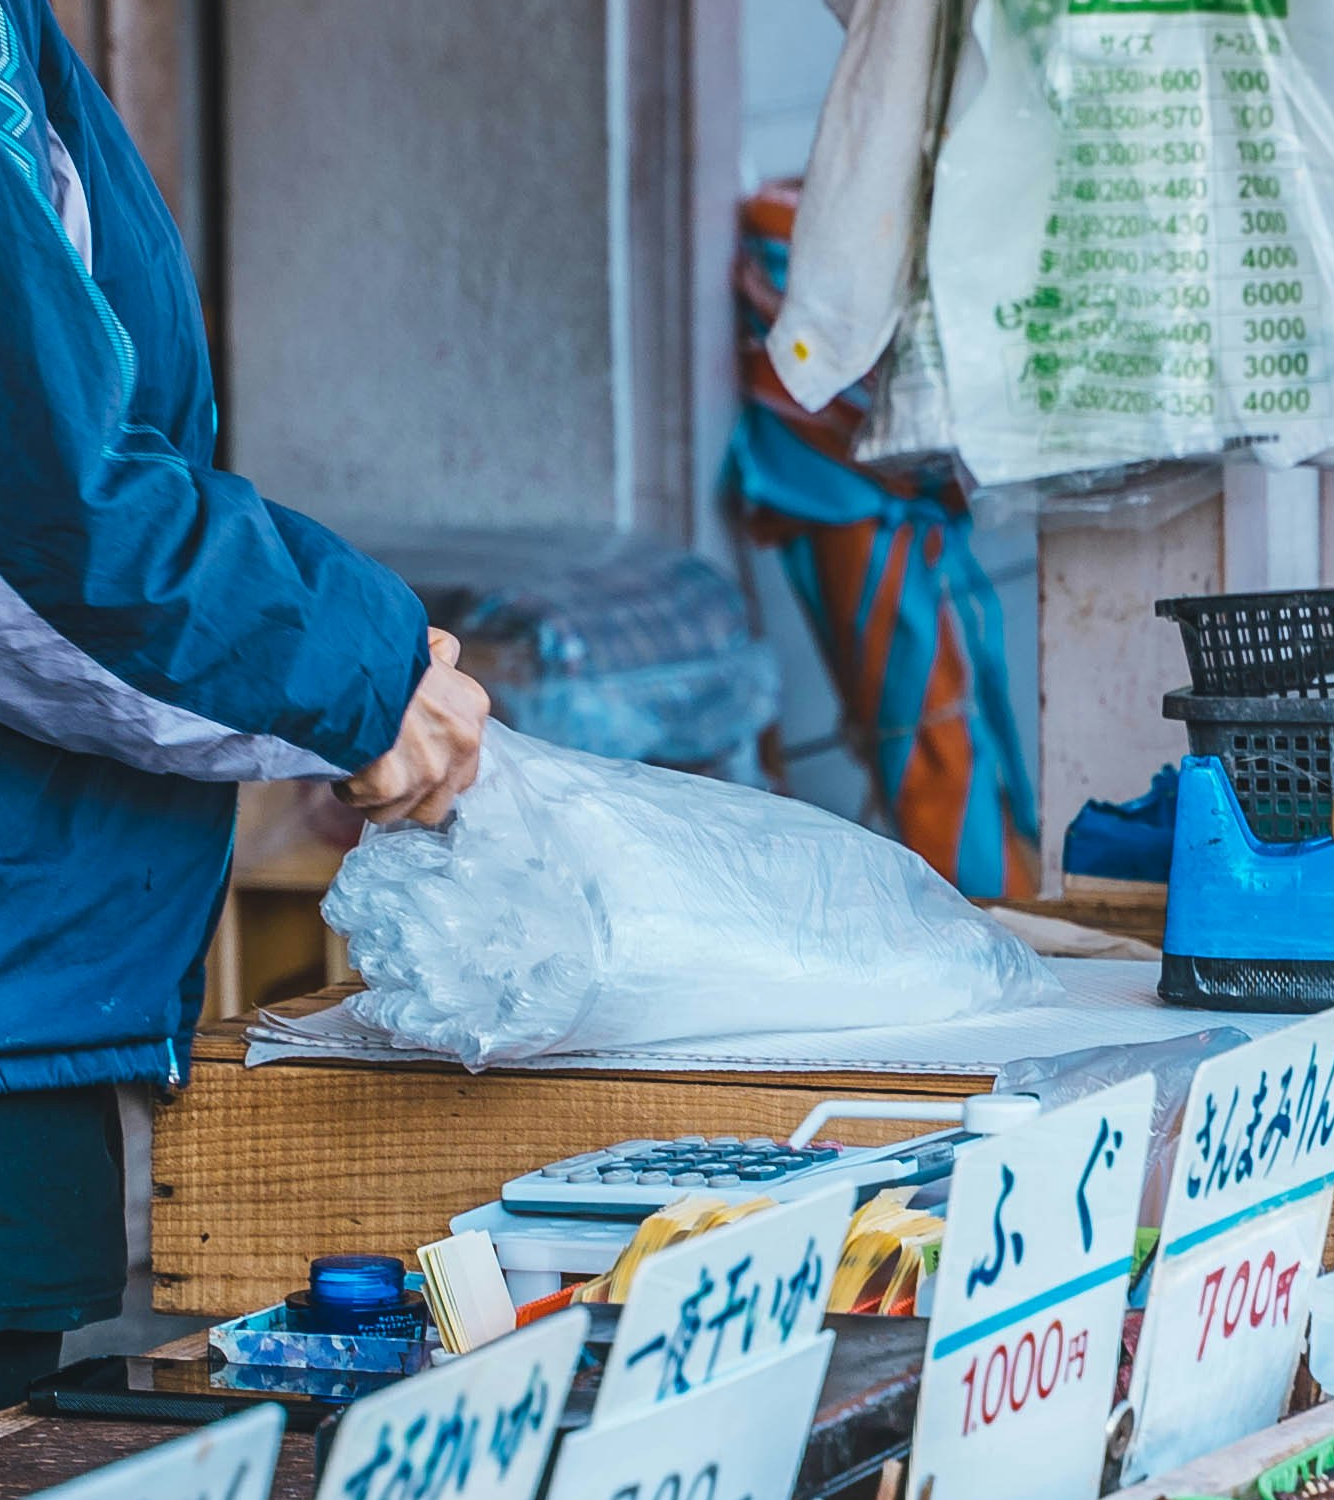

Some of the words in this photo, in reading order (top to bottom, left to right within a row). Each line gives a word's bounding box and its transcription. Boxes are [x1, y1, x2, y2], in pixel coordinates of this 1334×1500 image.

[1242, 281, 1304, 306] 6000
[1243, 318, 1307, 344] 3000
[1244, 352, 1309, 380] 3000
[1243, 387, 1312, 414] 4000
[966, 1116, 1124, 1300] ふぐ
[1197, 1249, 1302, 1363] 700円
